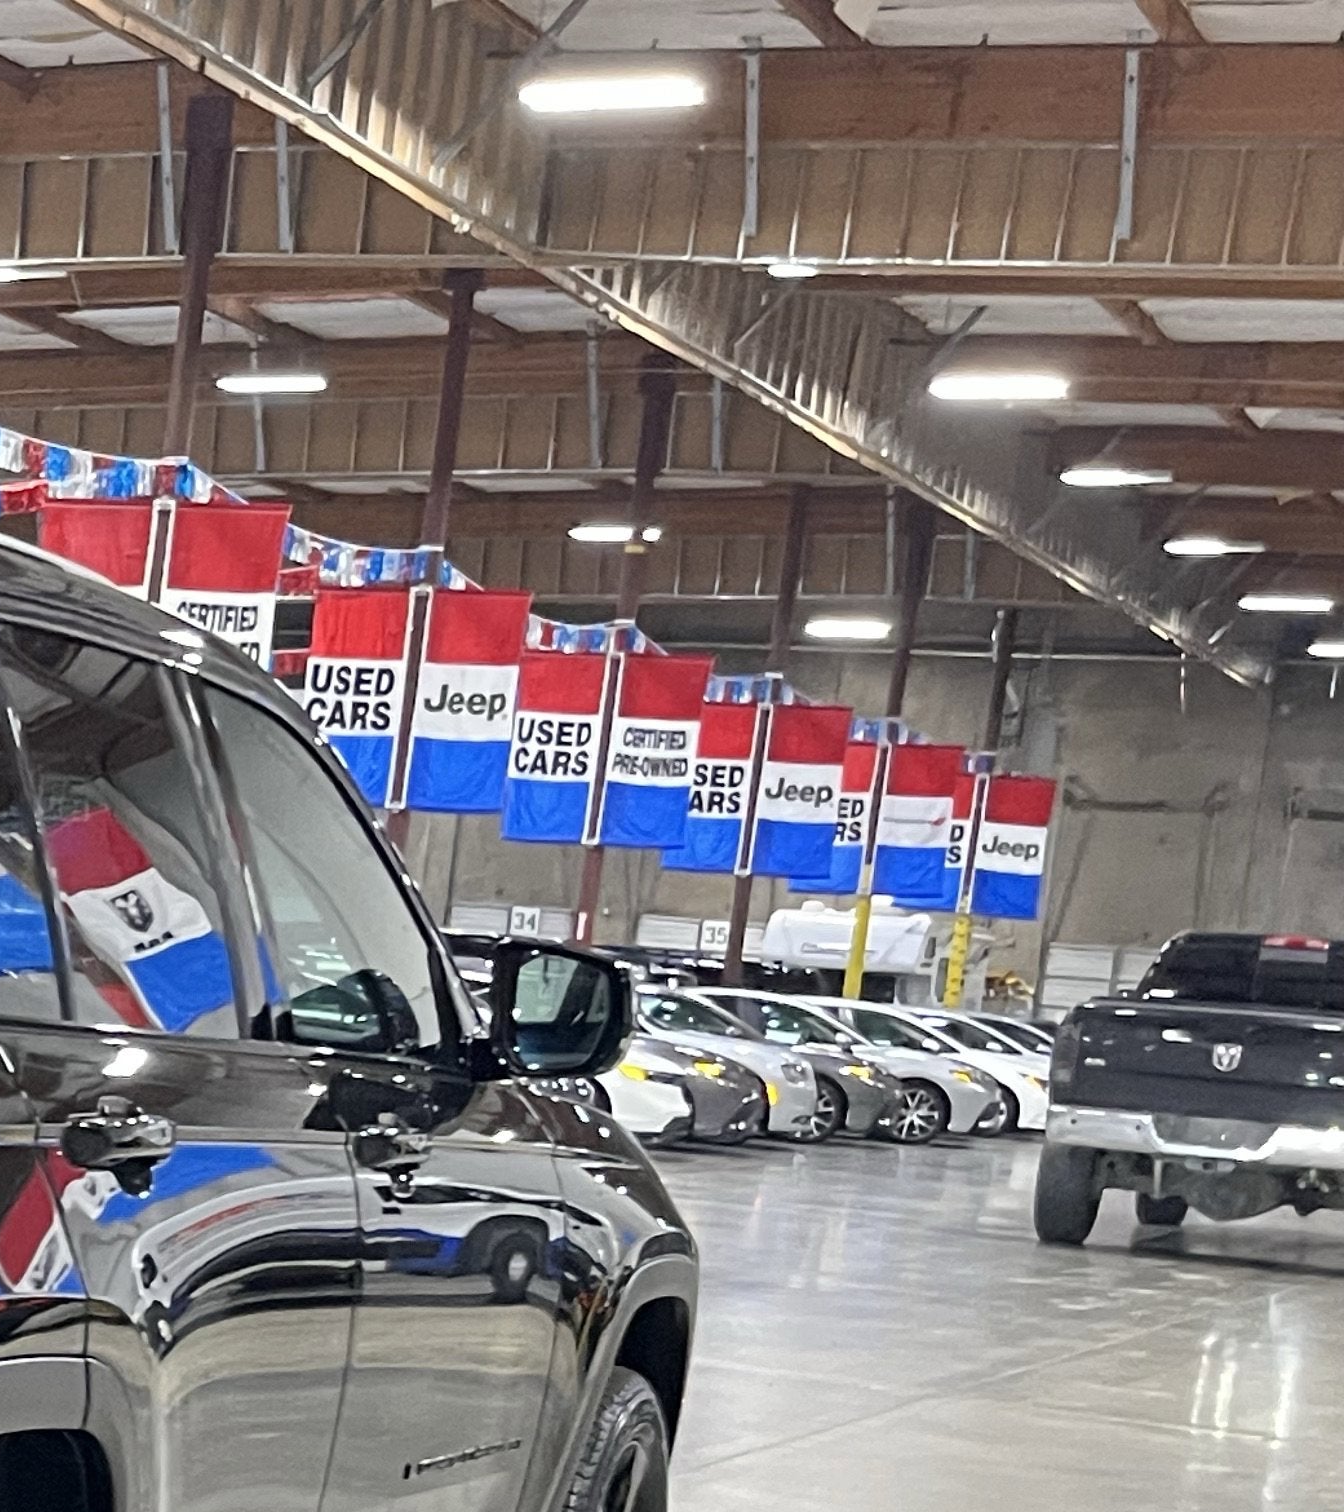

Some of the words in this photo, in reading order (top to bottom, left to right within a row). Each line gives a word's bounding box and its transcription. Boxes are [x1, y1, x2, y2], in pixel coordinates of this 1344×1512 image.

[313, 664, 395, 697] USED
[307, 696, 391, 730] CARS
[423, 684, 507, 721] Jeep
[517, 717, 592, 746] USED
[623, 726, 687, 750] CERTIFIED
[514, 747, 589, 776] CARS
[612, 752, 688, 778] PRE-OWNED
[693, 764, 745, 788] SED
[688, 790, 741, 814] ARS
[765, 777, 834, 808] Jeep
[837, 798, 865, 819] ED
[834, 821, 862, 842] RS
[982, 835, 1040, 861] Jeep
[514, 912, 536, 931] 34
[705, 926, 728, 945] 35
